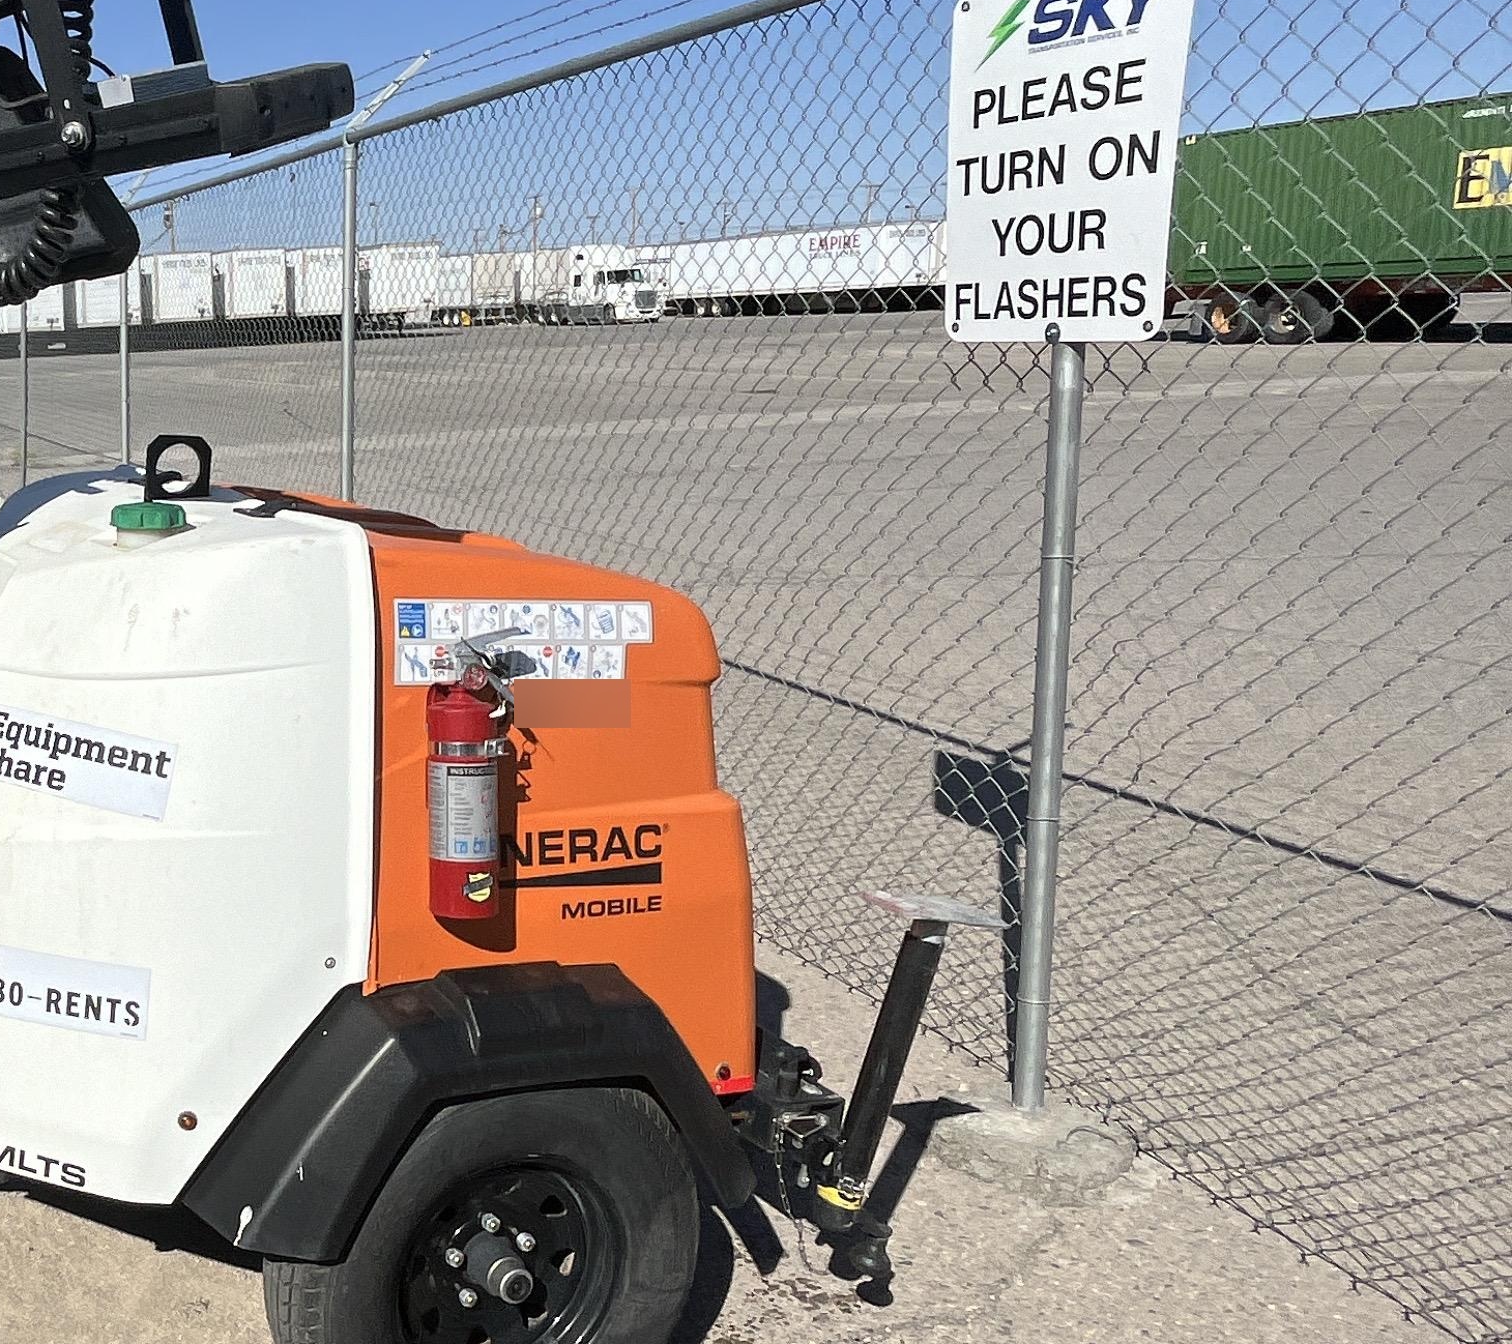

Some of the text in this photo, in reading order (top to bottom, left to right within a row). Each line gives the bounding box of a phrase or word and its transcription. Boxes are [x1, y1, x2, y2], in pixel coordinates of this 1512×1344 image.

[973, 58, 1147, 129] PLEASE
[955, 130, 1161, 197] TURN ON
[809, 234, 861, 252] EMPIRE
[991, 208, 1106, 258] YOUR
[954, 273, 1147, 321] FLASHERS
[500, 823, 663, 867] NERAC
[561, 895, 663, 920] MOBILE
